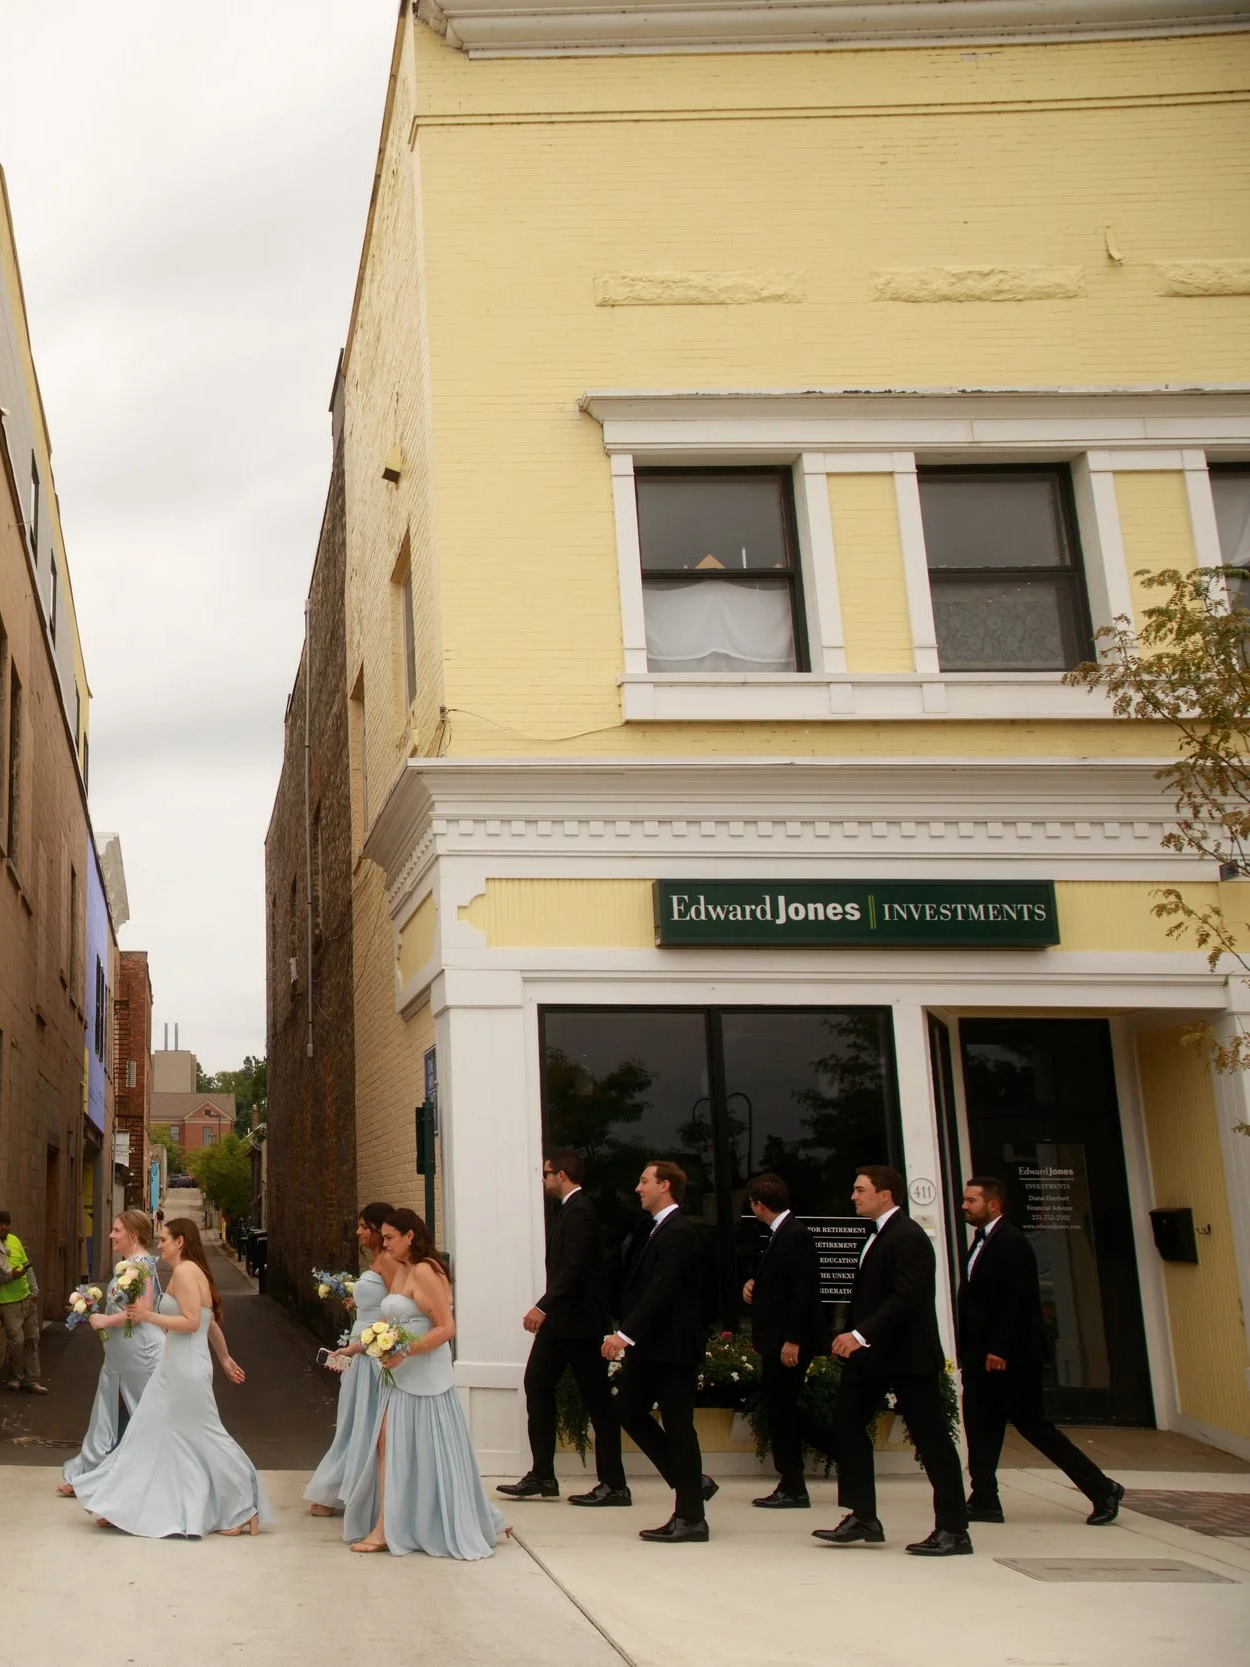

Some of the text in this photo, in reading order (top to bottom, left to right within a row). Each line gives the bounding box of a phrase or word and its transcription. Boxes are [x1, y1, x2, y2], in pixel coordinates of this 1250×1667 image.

[882, 903, 1047, 921] INVESTMENTS
[913, 1184, 932, 1199] 411
[822, 1226, 866, 1234] RETIREMENT
